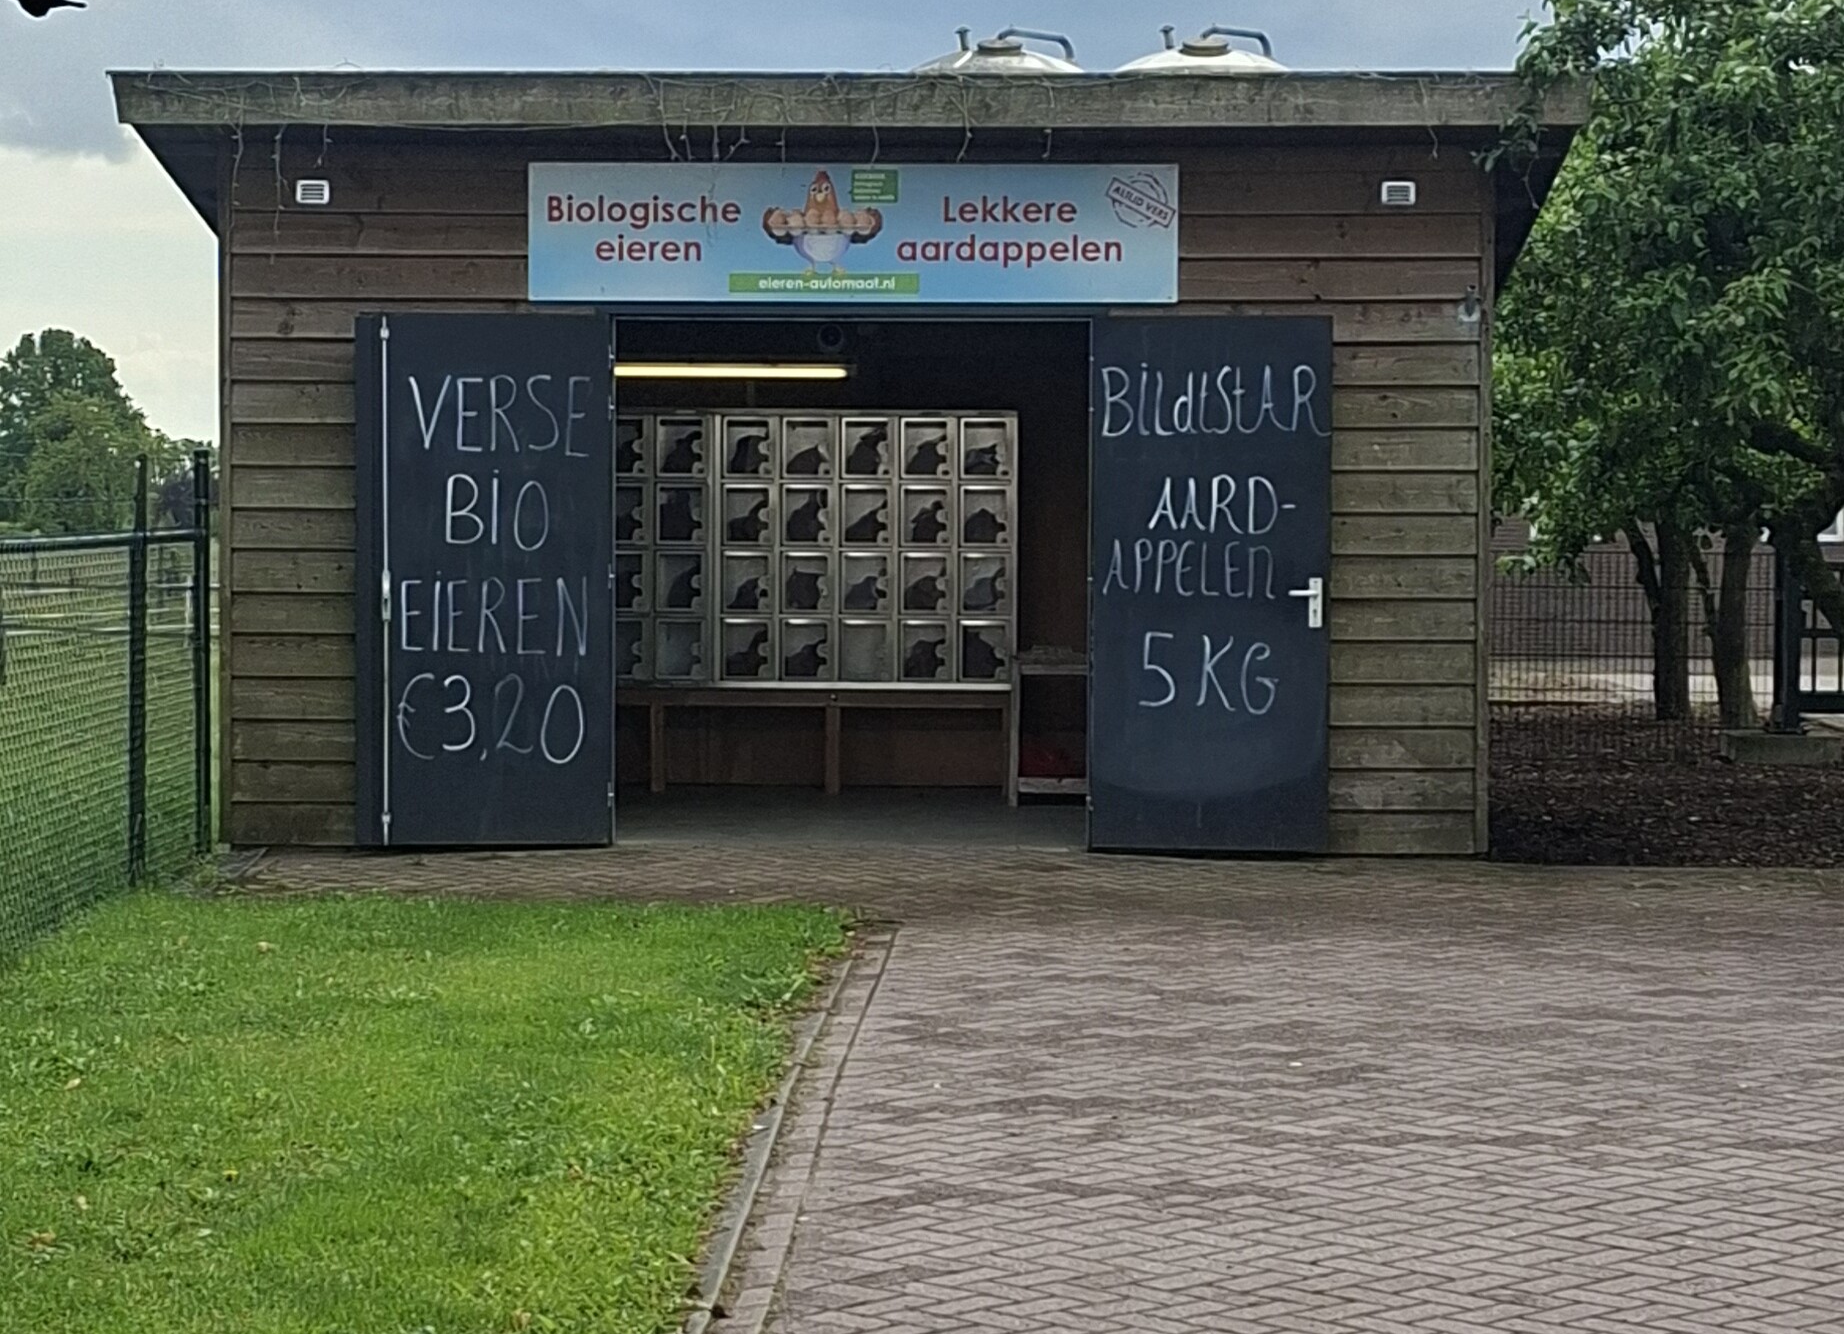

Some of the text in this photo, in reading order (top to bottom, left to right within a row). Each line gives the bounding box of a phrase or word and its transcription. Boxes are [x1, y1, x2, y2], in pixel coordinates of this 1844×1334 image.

[546, 194, 742, 231] Biologische
[942, 194, 1079, 224] Lekkere
[594, 233, 703, 263] eieren
[896, 233, 1124, 269] aardappelen
[758, 276, 896, 290] eieren-automaat.nl
[408, 373, 592, 458] VERSE
[444, 469, 550, 551] BIO
[1147, 473, 1297, 535] AARD-
[400, 571, 589, 657] EIEREN
[1138, 631, 1280, 715] 5 KG
[396, 673, 585, 764] €3,20
